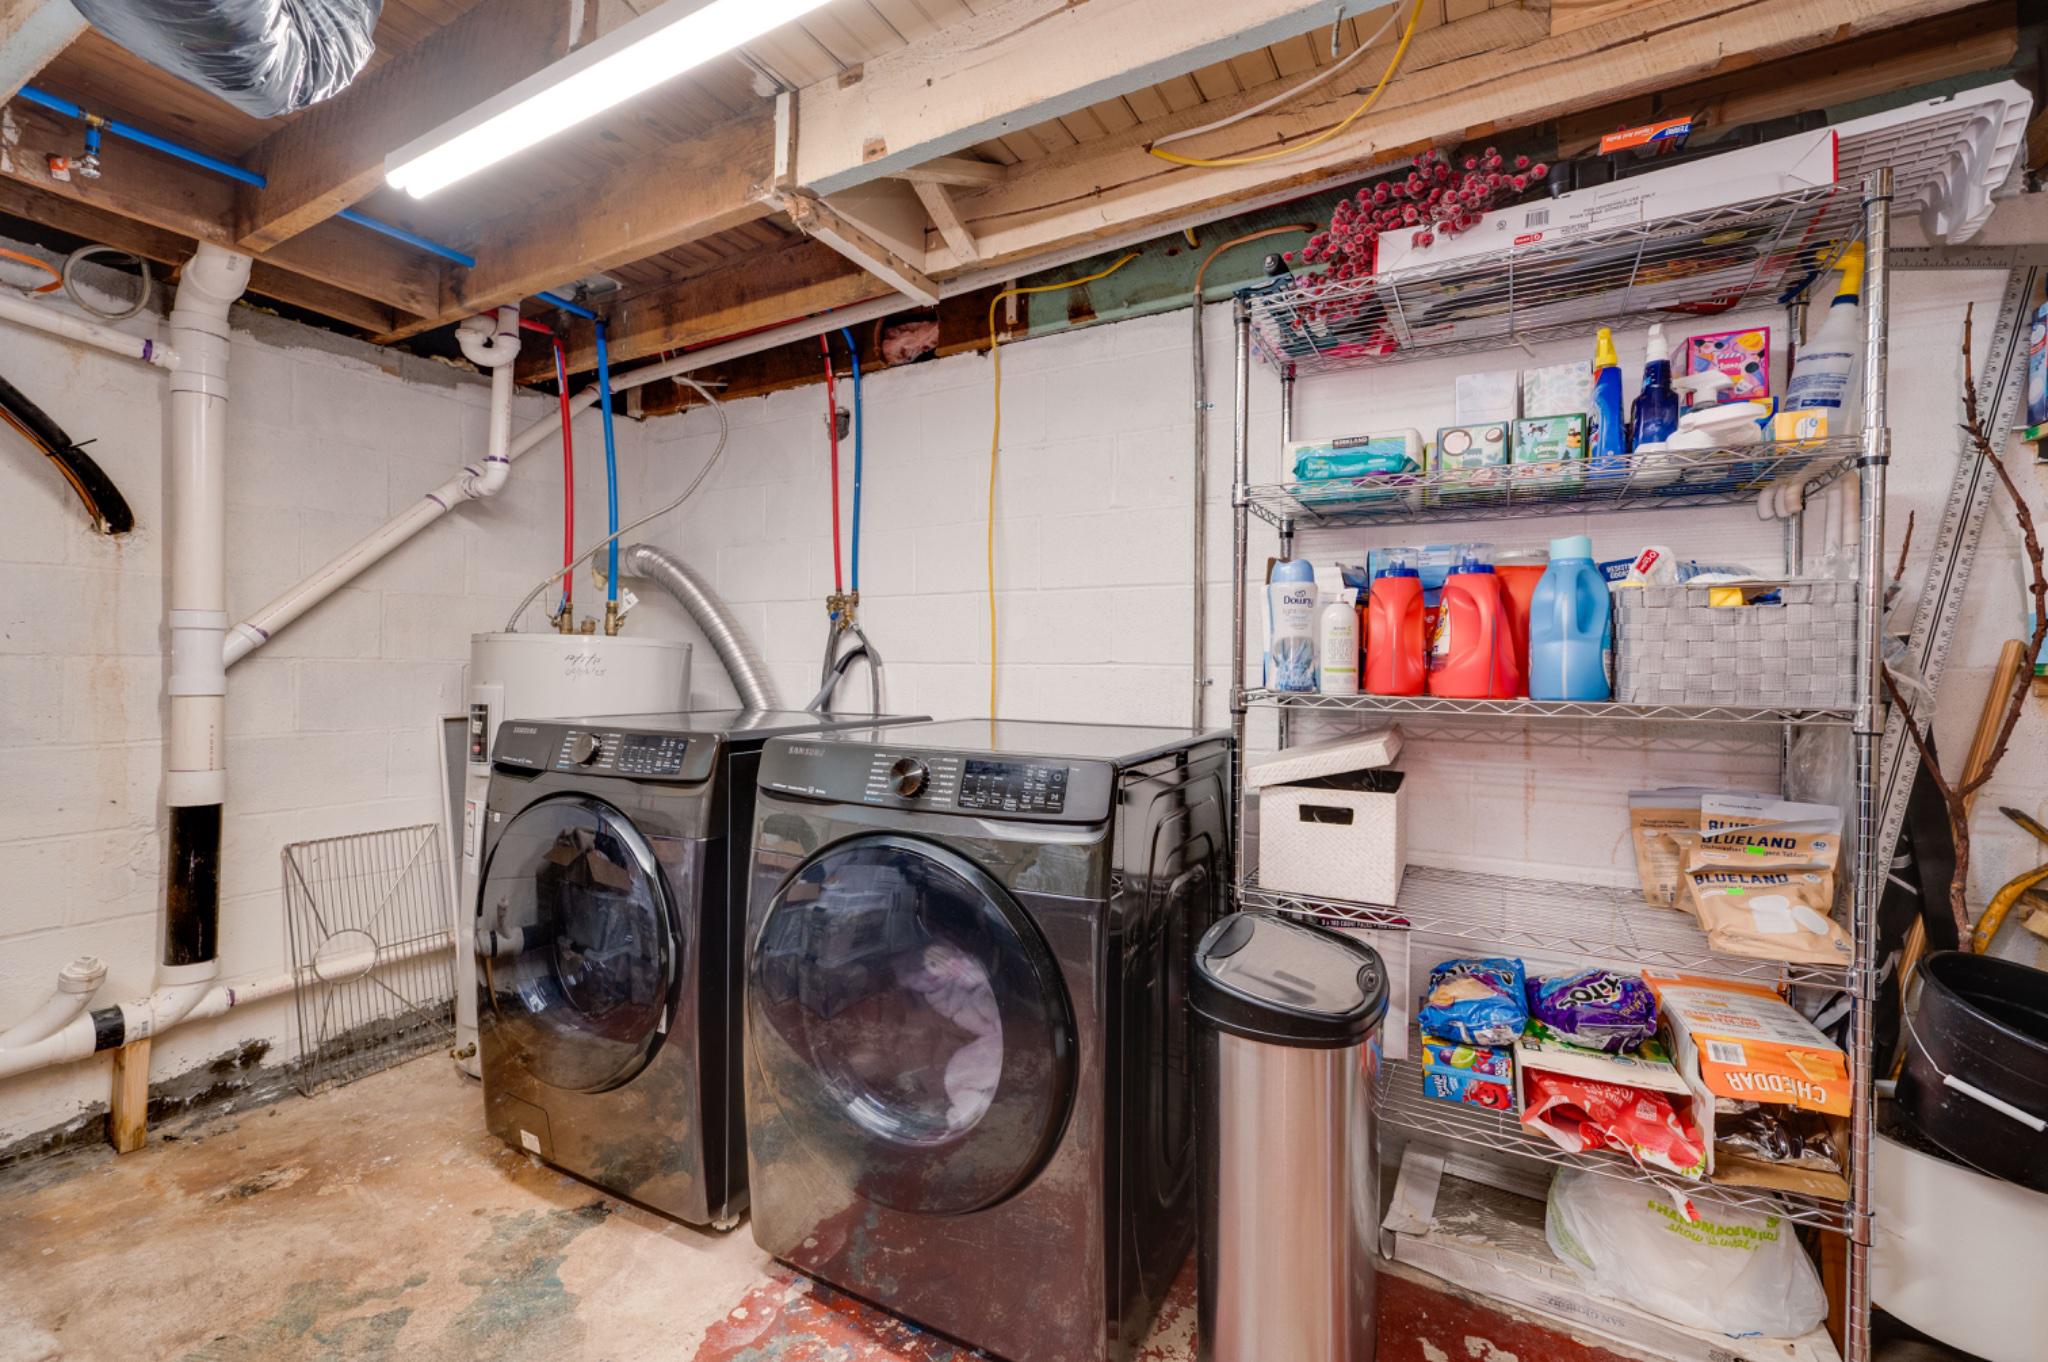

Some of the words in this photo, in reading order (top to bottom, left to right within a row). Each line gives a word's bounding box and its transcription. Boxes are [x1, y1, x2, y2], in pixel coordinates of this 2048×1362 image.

[1283, 594, 1313, 608] Downy
[513, 726, 538, 735] SAMSUNG
[788, 746, 826, 758] SAMSUNG
[1701, 834, 1797, 850] BLUELAND
[1812, 841, 1827, 849] 40
[1693, 872, 1789, 886] BLUELAND
[1724, 1071, 1827, 1104] CHEDDAR
